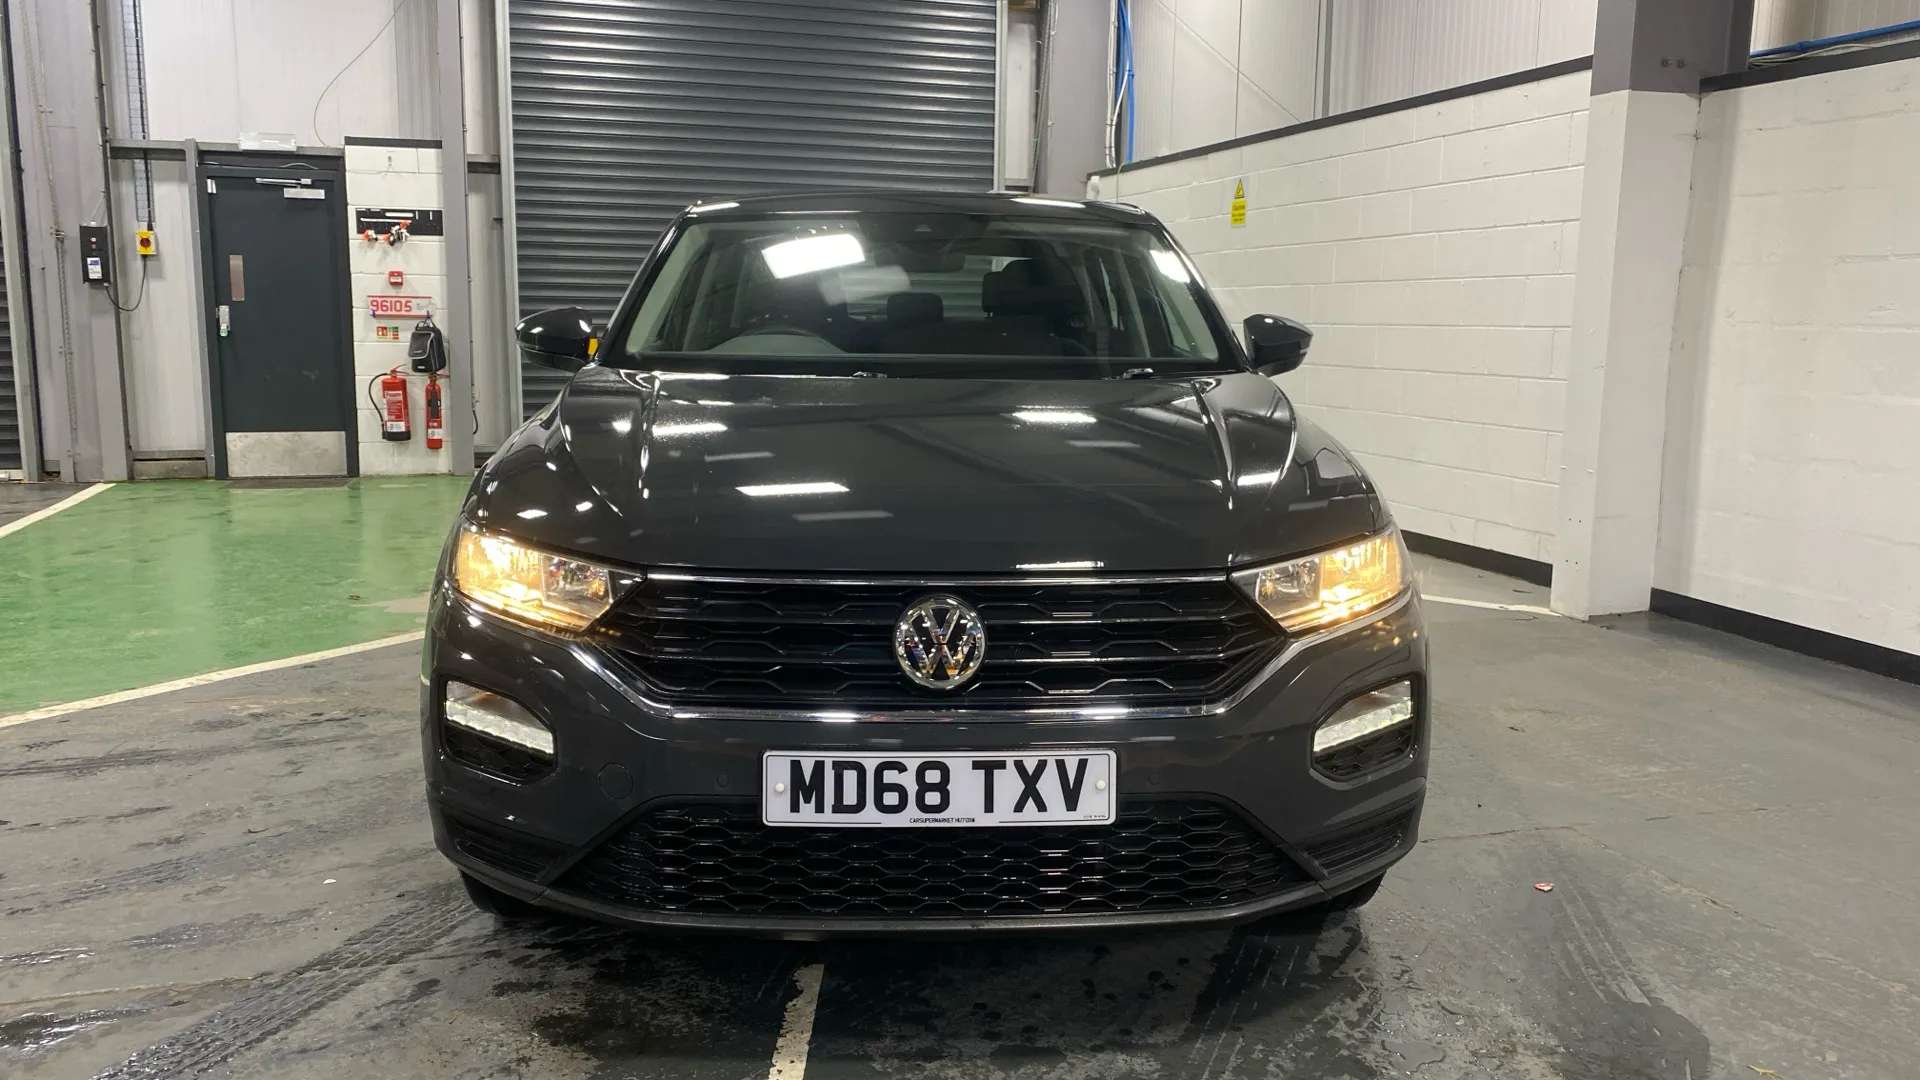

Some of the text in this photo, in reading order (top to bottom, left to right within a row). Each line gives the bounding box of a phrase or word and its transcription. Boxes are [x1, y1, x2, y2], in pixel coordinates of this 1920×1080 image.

[370, 300, 412, 312] 96105
[789, 758, 1088, 814] MD68 TXV
